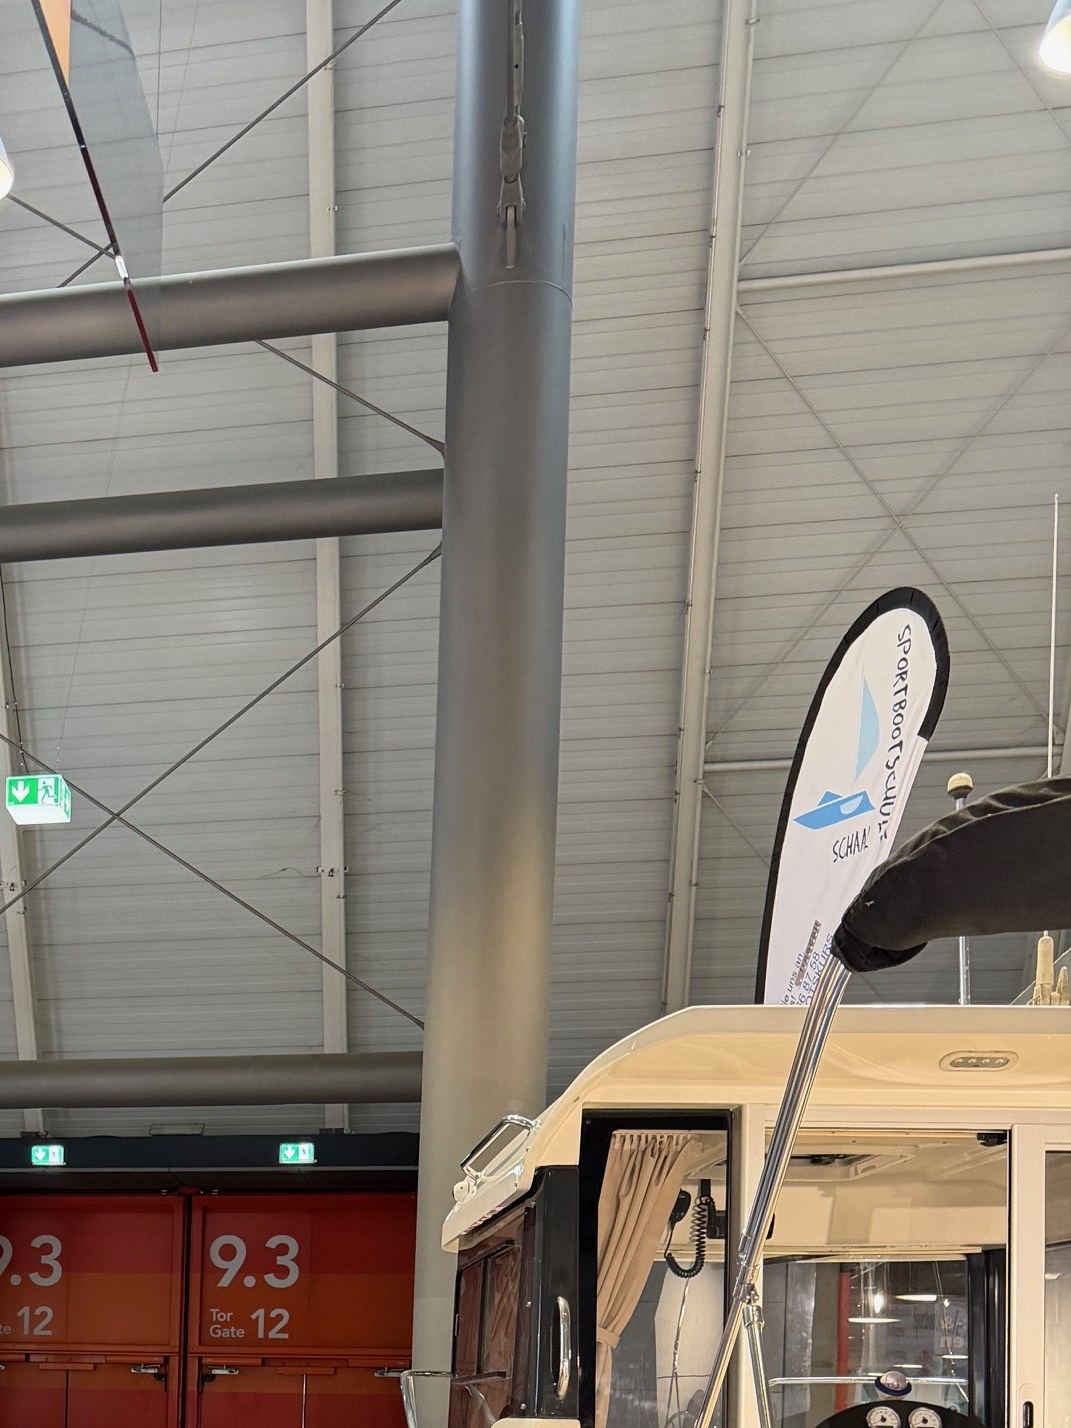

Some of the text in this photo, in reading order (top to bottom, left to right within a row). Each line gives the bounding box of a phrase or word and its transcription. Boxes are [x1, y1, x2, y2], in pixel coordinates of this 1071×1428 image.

[209, 1234, 300, 1289] 9.3
[16, 1306, 54, 1336] 12
[209, 1308, 234, 1322] Tor
[250, 1308, 290, 1339] 12
[209, 1324, 245, 1339] Gate
